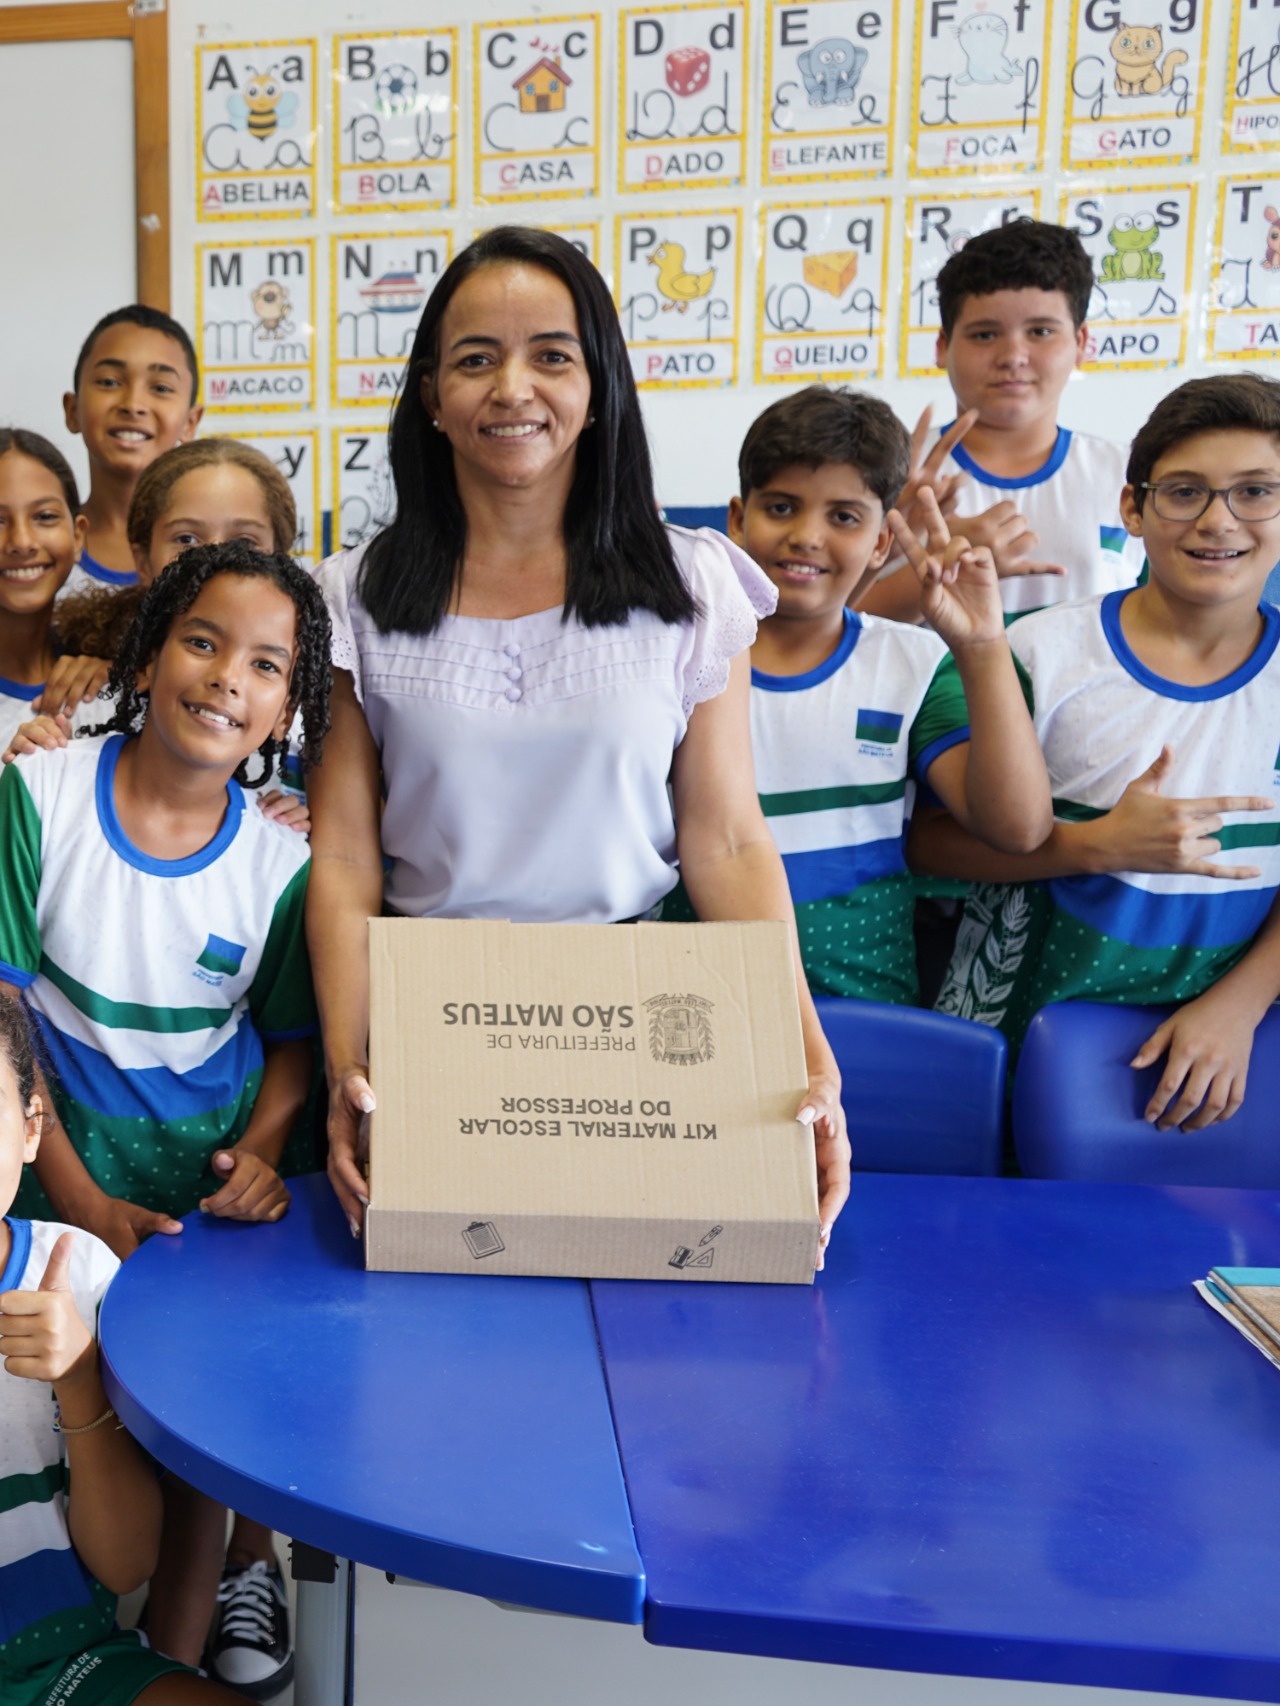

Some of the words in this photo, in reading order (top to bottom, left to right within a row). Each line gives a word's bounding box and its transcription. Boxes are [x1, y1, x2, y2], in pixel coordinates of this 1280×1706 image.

[780, 9, 809, 46] E
[856, 11, 881, 39] e
[930, 0, 958, 38] F
[1085, 0, 1120, 33] G
[1170, 0, 1197, 33] g
[634, 19, 664, 56] D
[709, 13, 735, 50] d
[347, 45, 375, 81] B
[425, 40, 450, 76] b
[486, 32, 517, 69] C
[563, 31, 587, 58] c
[206, 54, 238, 91] A
[282, 56, 304, 82] a
[689, 70, 737, 138] d
[851, 95, 882, 126] e
[343, 114, 388, 164] B
[484, 102, 517, 151] C
[553, 116, 589, 148] c
[1098, 127, 1171, 151] GATO
[265, 139, 313, 169] a
[772, 141, 885, 168] ELEFANTE
[945, 135, 1017, 160] FOCA
[500, 160, 574, 185] CASA
[646, 152, 724, 177] DADO
[203, 180, 309, 204] ABELHA
[359, 173, 431, 196] BOLA
[1076, 200, 1102, 236] S
[1155, 201, 1180, 227] s
[1232, 186, 1262, 223] T
[773, 214, 807, 251] Q
[847, 217, 873, 253] q
[921, 207, 952, 242] R
[629, 227, 656, 262] P
[706, 224, 731, 261] p
[210, 253, 242, 287] M
[269, 250, 304, 276] m
[345, 244, 373, 279] N
[415, 248, 438, 274] n
[775, 343, 868, 368] QUEIJO
[1086, 334, 1159, 356] SAPO
[647, 353, 715, 376] PATO
[211, 376, 303, 396] MACACO
[360, 372, 406, 389] NAV
[442, 1002, 563, 1027] MATEUS
[573, 1004, 634, 1032] SÃO
[486, 1034, 512, 1049] DE
[518, 1035, 635, 1051] PREFEITURA
[500, 1097, 632, 1115] PROFESSOR
[640, 1100, 671, 1116] DO
[458, 1118, 561, 1136] ESCOLAR
[567, 1121, 676, 1138] MATERIAL
[683, 1123, 717, 1139] KIT
[44, 1664, 80, 1706] REFEITURA
[77, 1652, 91, 1665] DE
[63, 1657, 102, 1698] MATEUS
